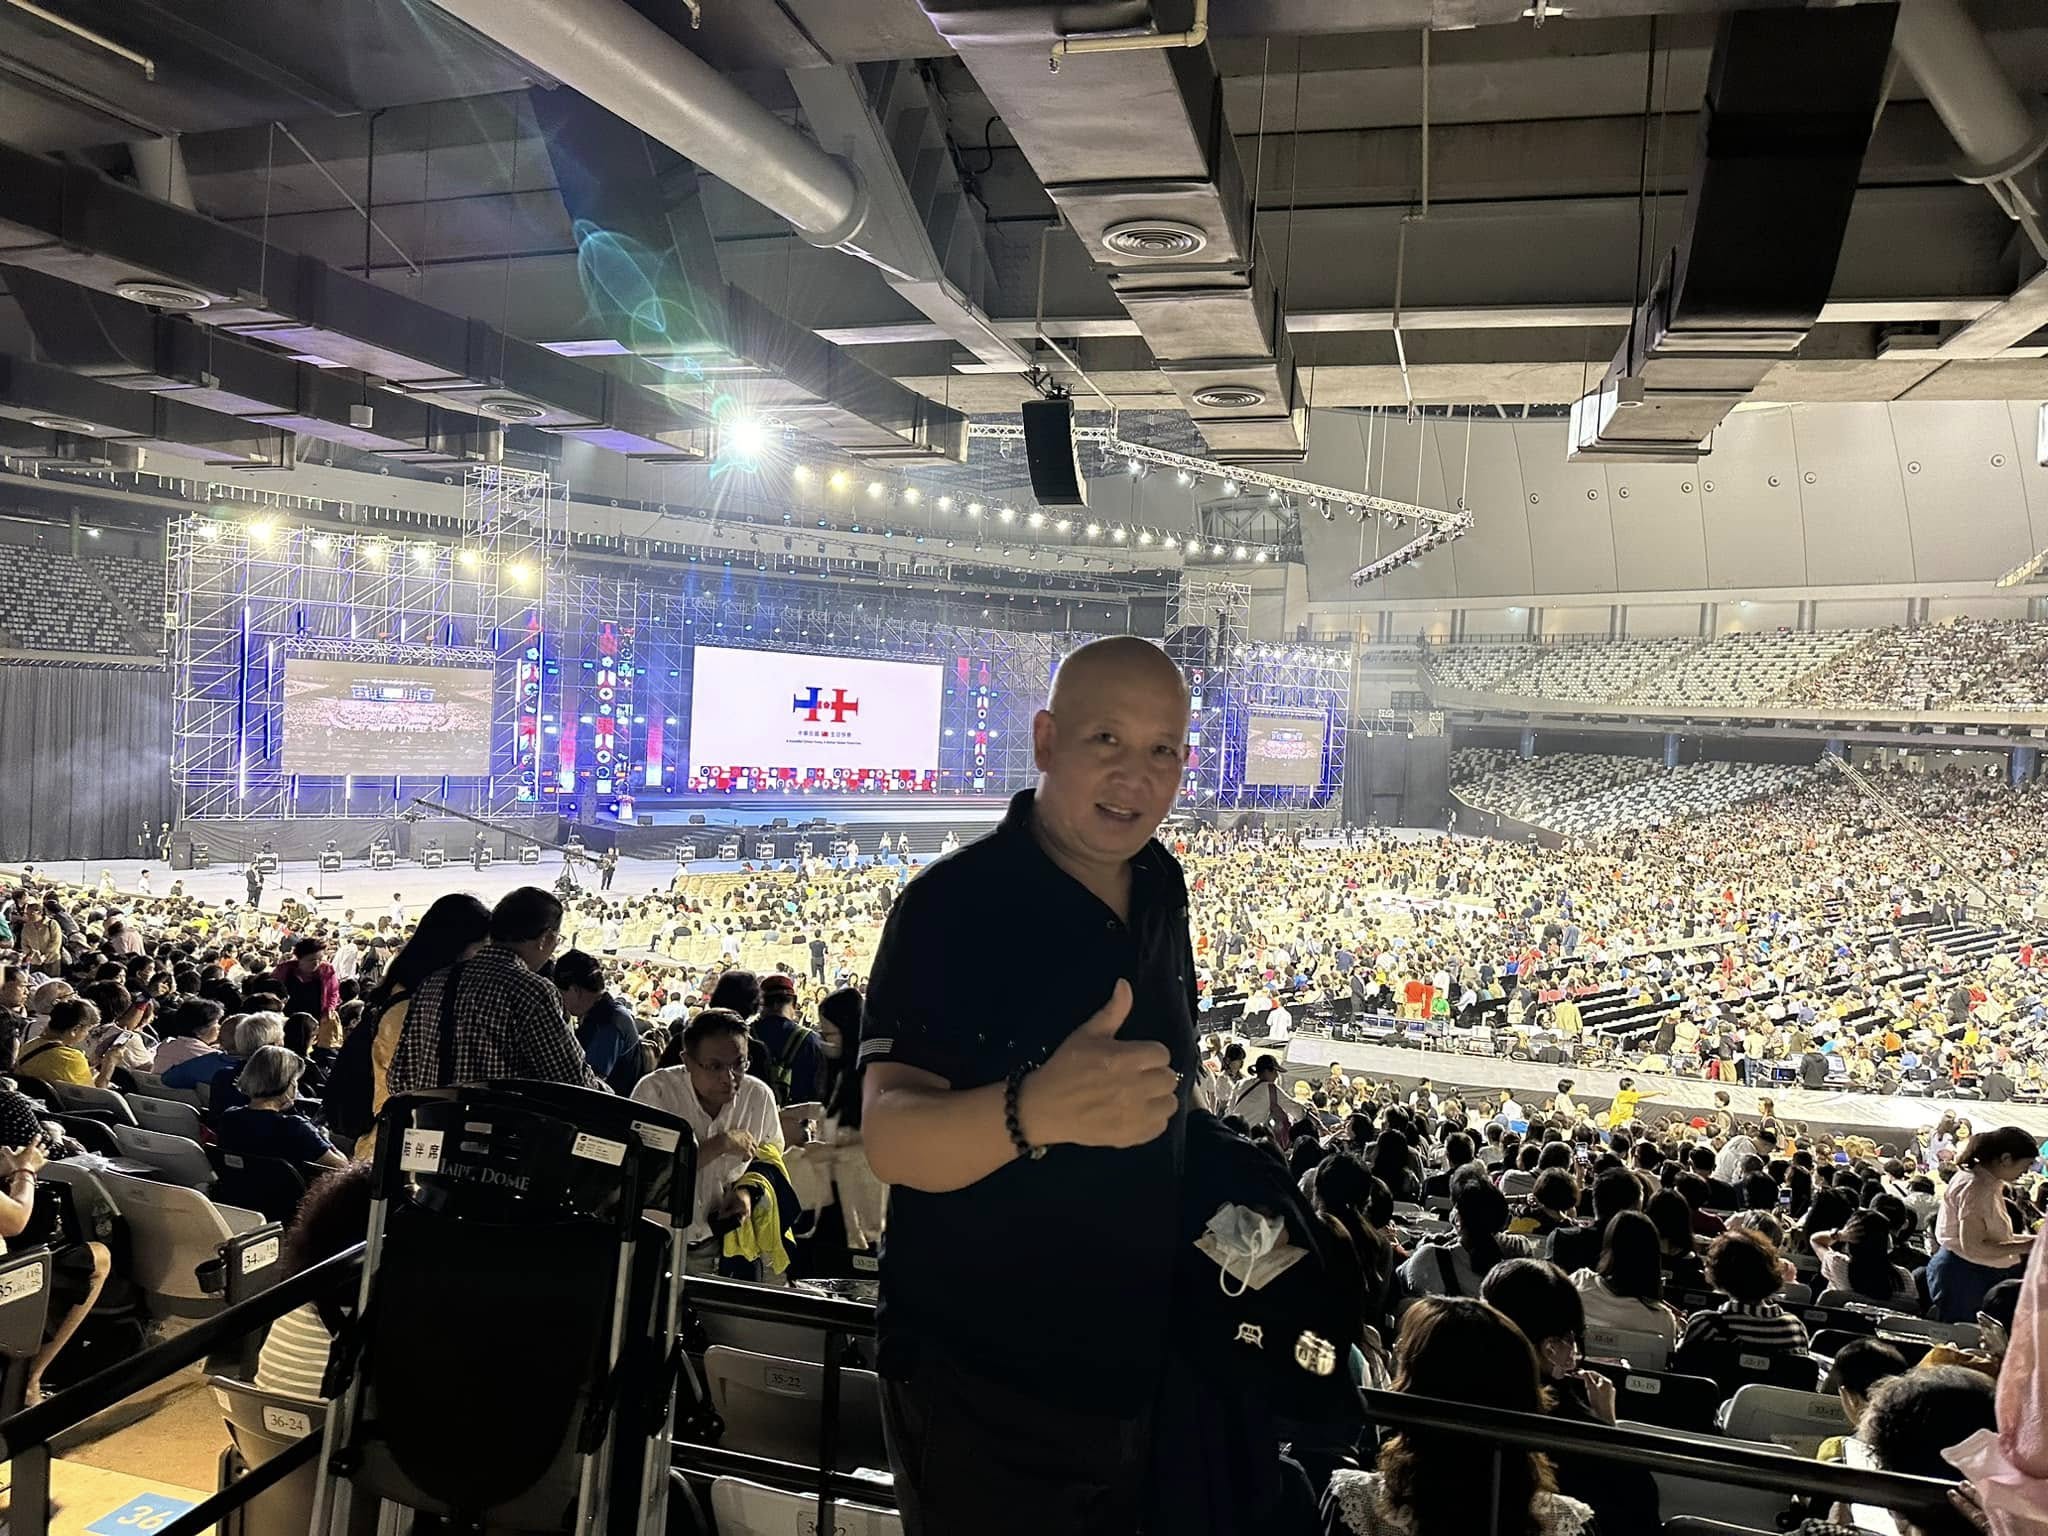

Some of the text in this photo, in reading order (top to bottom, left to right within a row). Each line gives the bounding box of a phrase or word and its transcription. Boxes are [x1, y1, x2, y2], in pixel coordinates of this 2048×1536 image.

[481, 1167, 531, 1192] DOME
[270, 1413, 304, 1431] 36-24
[116, 1505, 175, 1530] 36
